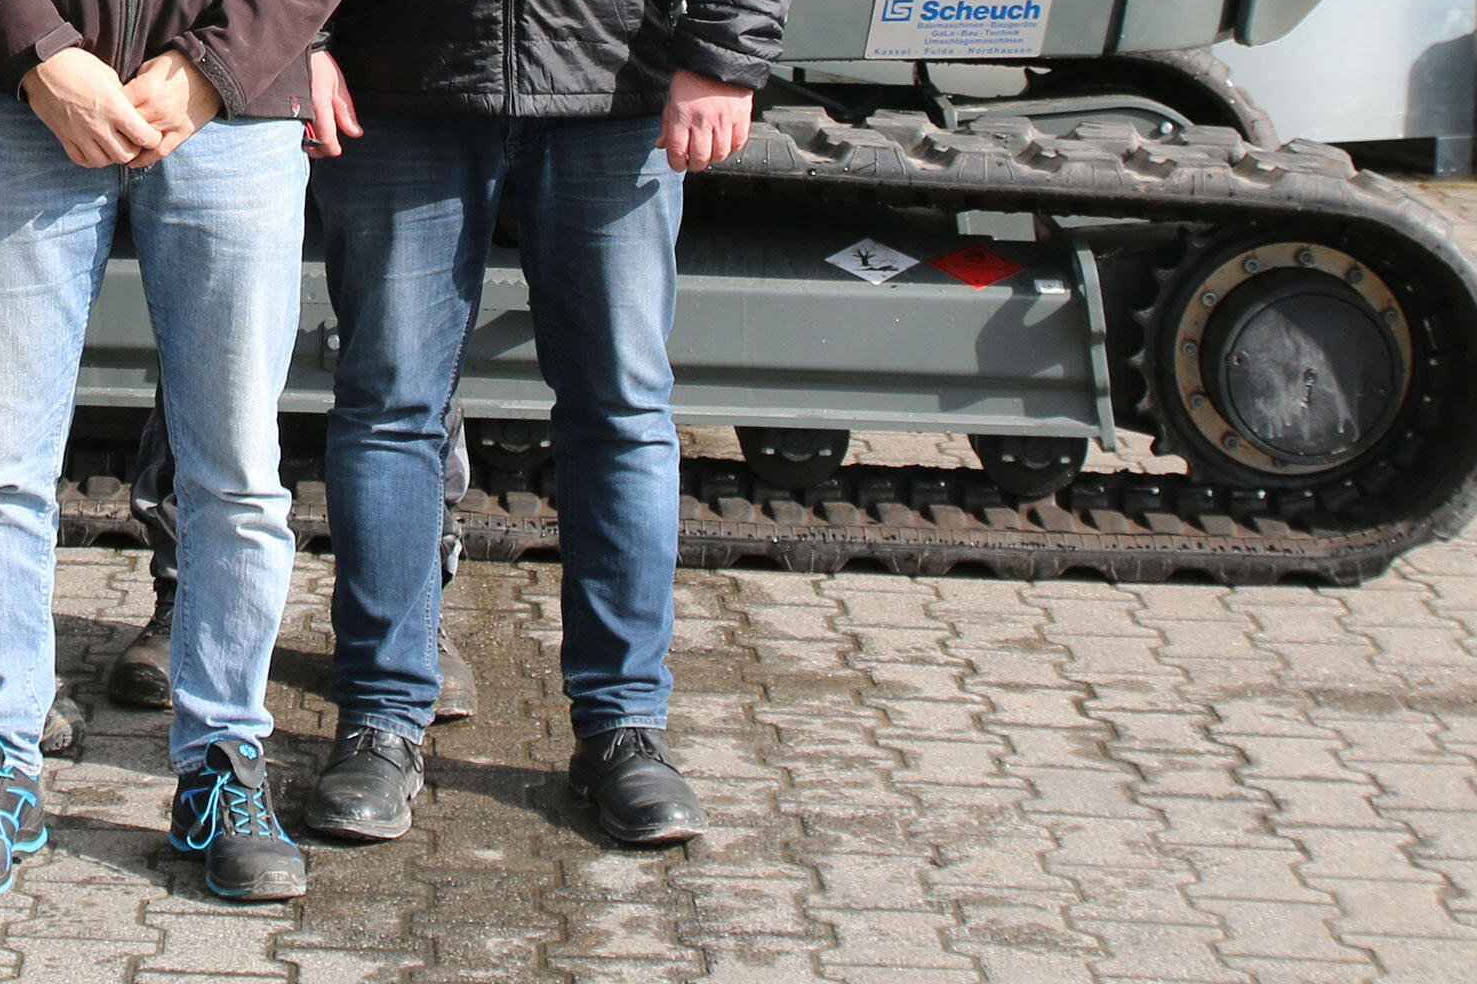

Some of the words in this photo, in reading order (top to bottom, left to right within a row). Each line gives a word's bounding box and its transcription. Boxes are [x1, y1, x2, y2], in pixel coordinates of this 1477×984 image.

[919, 0, 1041, 21] Scheuch
[917, 22, 985, 30] Baumaschinen
[990, 21, 1038, 30] Baugeräte
[924, 37, 1024, 46] Umschlagsmaschinen
[874, 48, 911, 56] Kassel
[924, 47, 954, 55] Fulda
[967, 47, 1033, 55] Nordhausen
